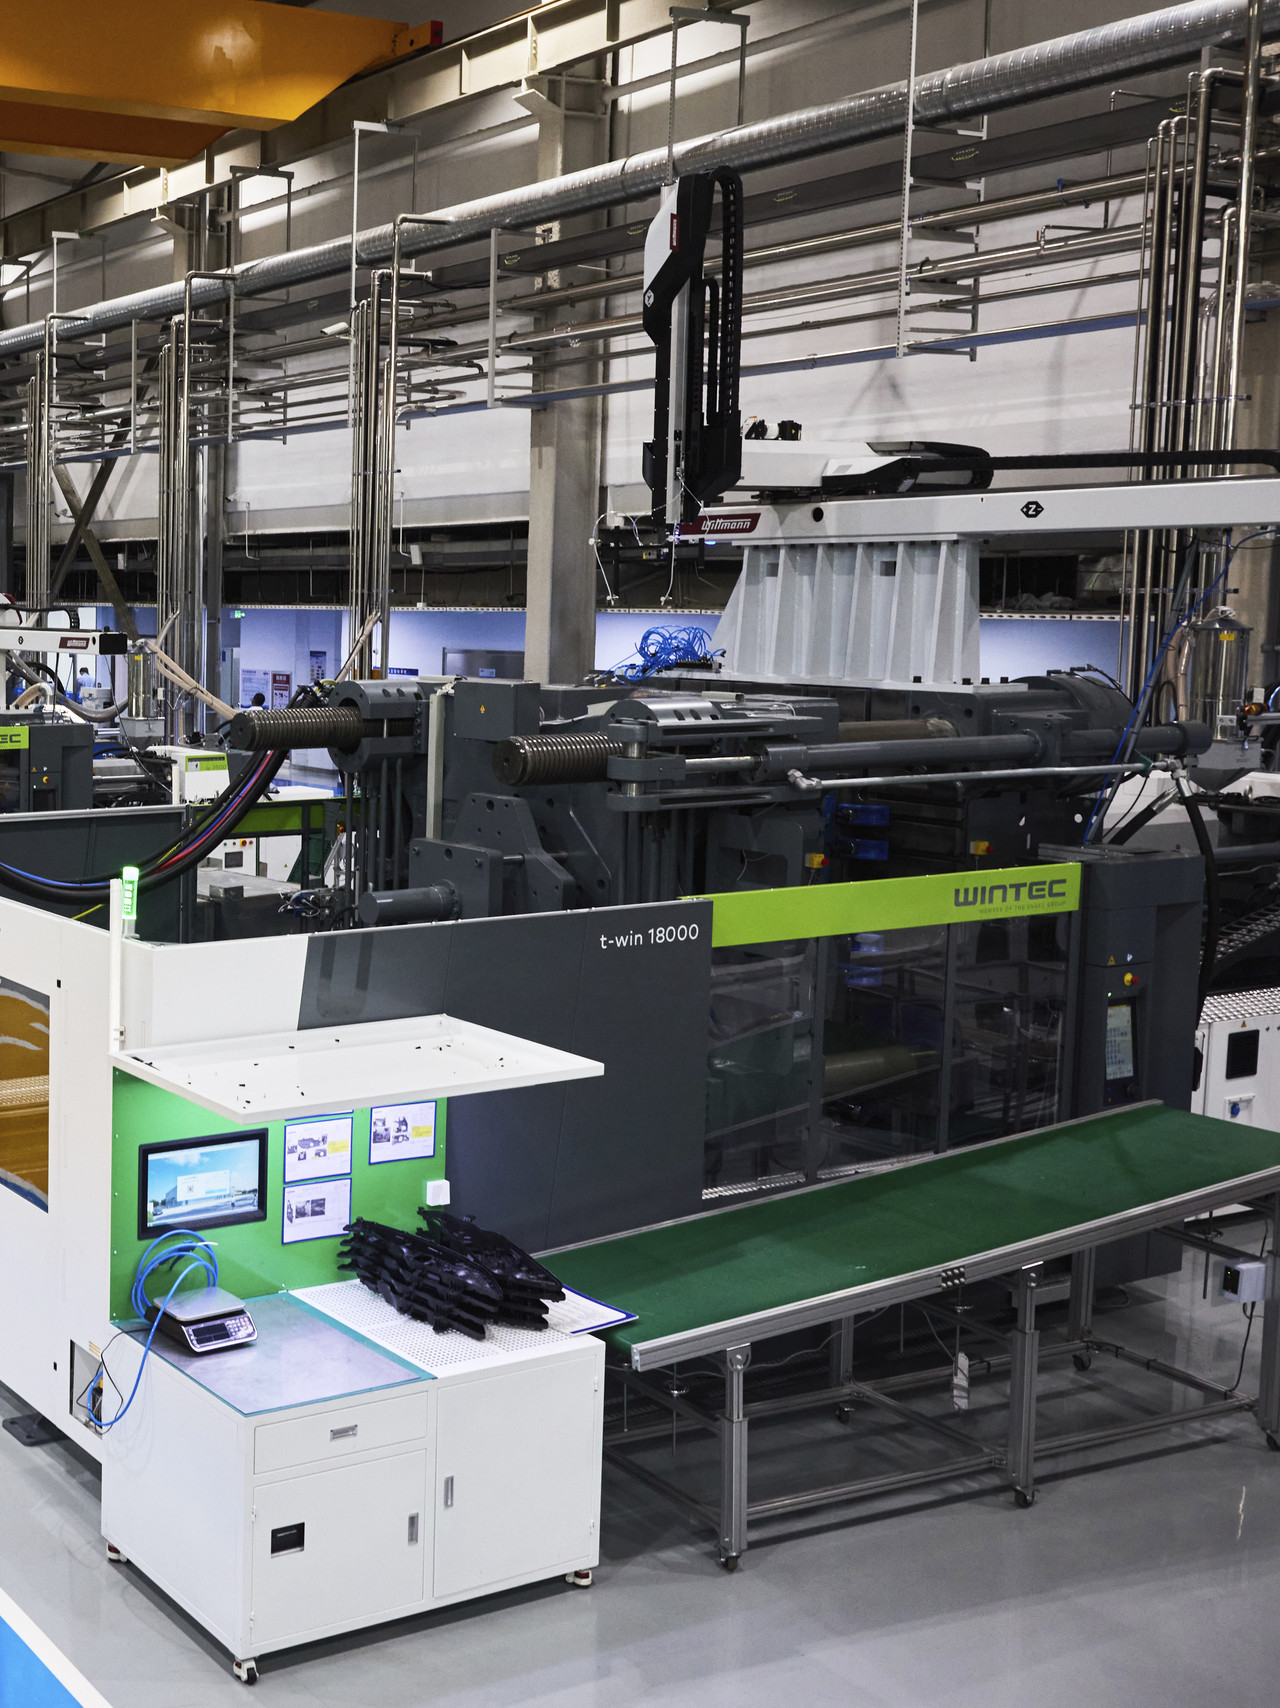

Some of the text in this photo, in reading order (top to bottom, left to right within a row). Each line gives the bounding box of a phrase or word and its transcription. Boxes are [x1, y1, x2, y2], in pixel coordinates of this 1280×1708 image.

[701, 518, 752, 530] Wittmann
[954, 879, 1067, 907] WINTEC
[600, 923, 699, 949] t-win 18000
